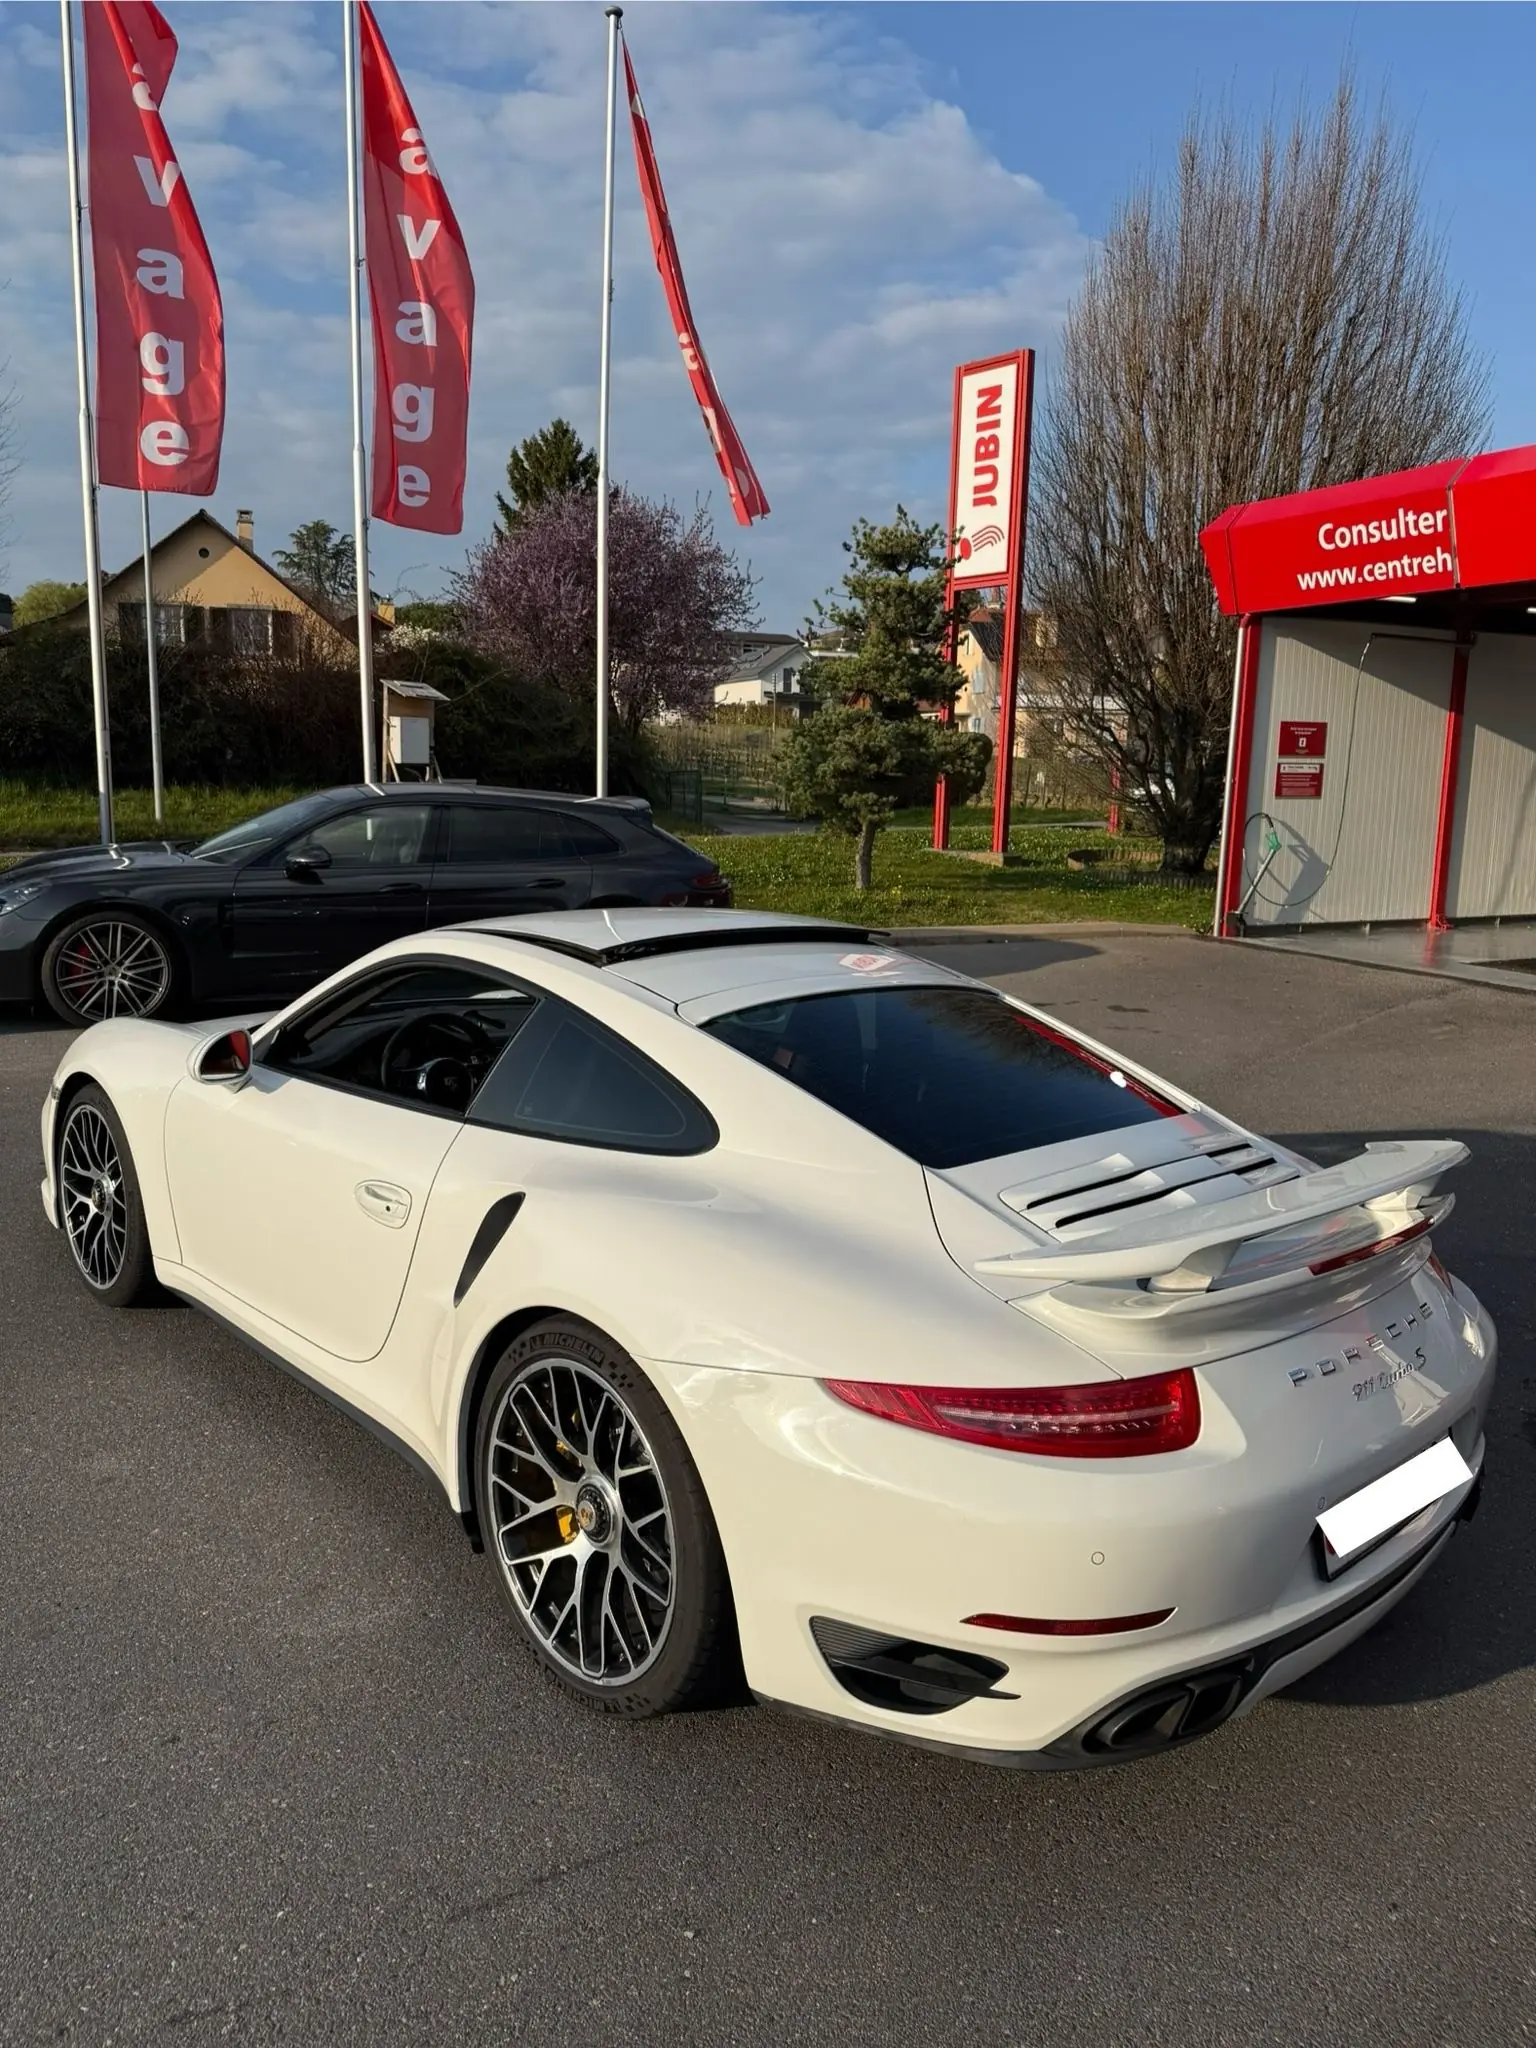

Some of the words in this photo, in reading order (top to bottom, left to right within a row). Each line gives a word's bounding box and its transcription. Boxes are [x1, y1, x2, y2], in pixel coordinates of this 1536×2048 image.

[972, 384, 1003, 508] JUBIN
[1318, 508, 1447, 550] Consulter
[1297, 546, 1453, 591] www.centreh
[543, 1333, 605, 1366] MICHELIN
[1287, 1302, 1433, 1387] PORSCHE
[1352, 1378, 1376, 1400] 911
[1377, 1360, 1415, 1390] Turbo
[1415, 1346, 1428, 1371] S
